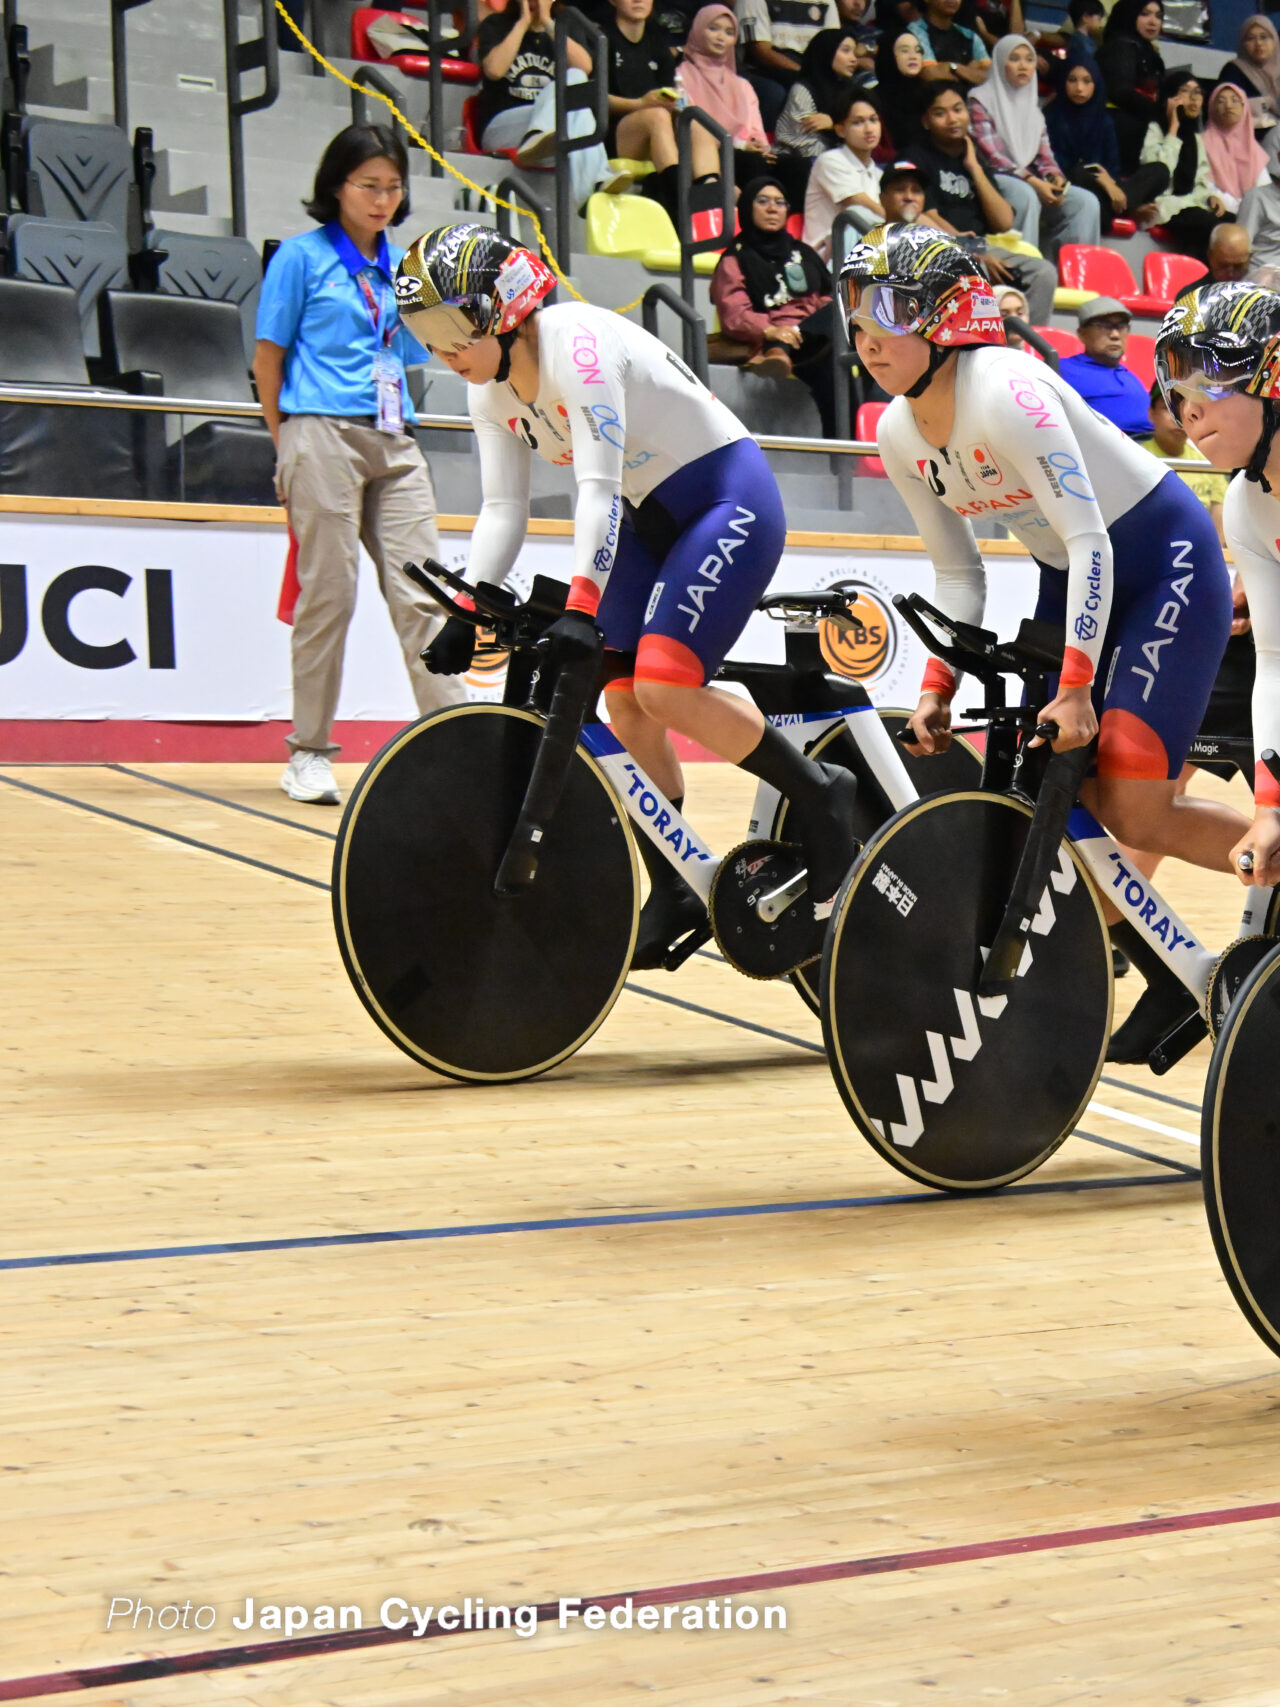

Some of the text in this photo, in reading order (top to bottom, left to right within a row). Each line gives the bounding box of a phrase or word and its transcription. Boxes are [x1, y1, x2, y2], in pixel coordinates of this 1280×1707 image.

[959, 319, 1006, 332] JAPAN
[1036, 456, 1064, 499] KEIRIN
[606, 494, 621, 548] Cyclers
[676, 505, 757, 635] JAPAN
[1084, 550, 1102, 612] Cyclers
[837, 625, 882, 650] KBS
[1130, 540, 1194, 703] JAPAN
[1194, 741, 1219, 755] Magic
